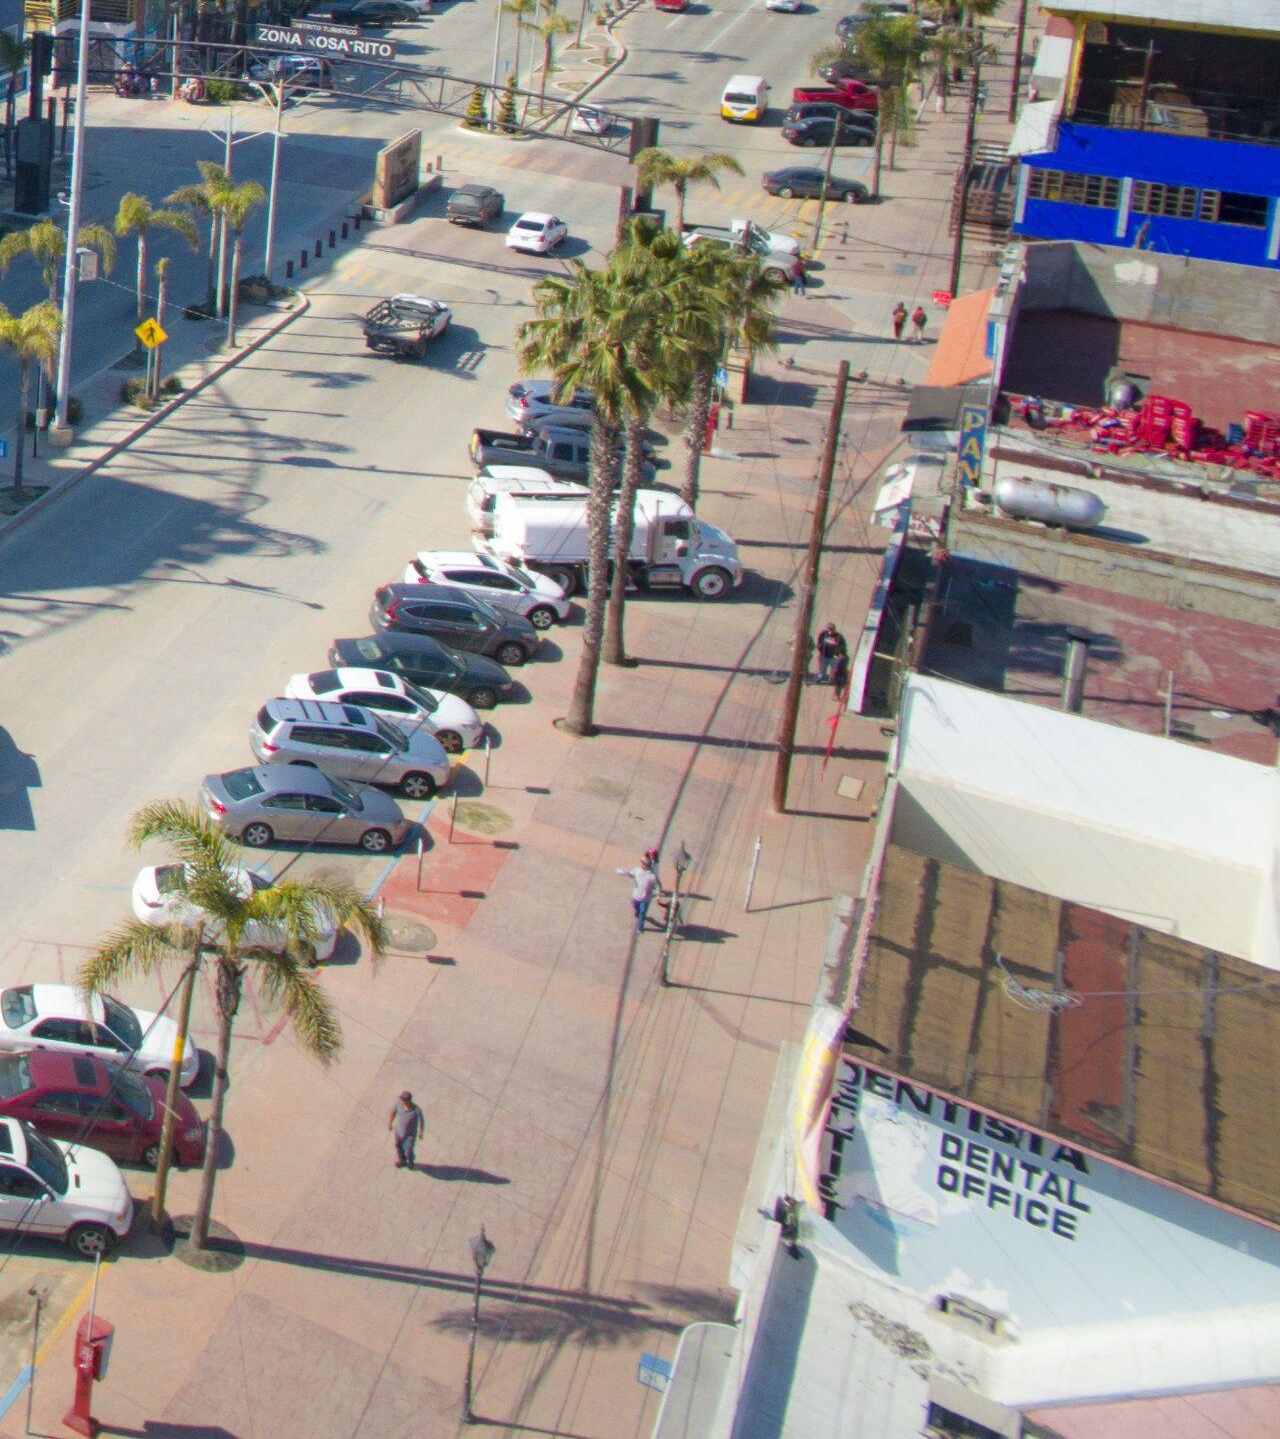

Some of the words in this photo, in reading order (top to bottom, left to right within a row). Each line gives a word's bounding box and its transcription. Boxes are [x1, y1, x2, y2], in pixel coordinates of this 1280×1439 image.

[258, 28, 303, 46] ZONA
[959, 411, 986, 481] PAN
[937, 1163, 1080, 1242] OFFICE
[940, 1131, 1092, 1214] DENTAL
